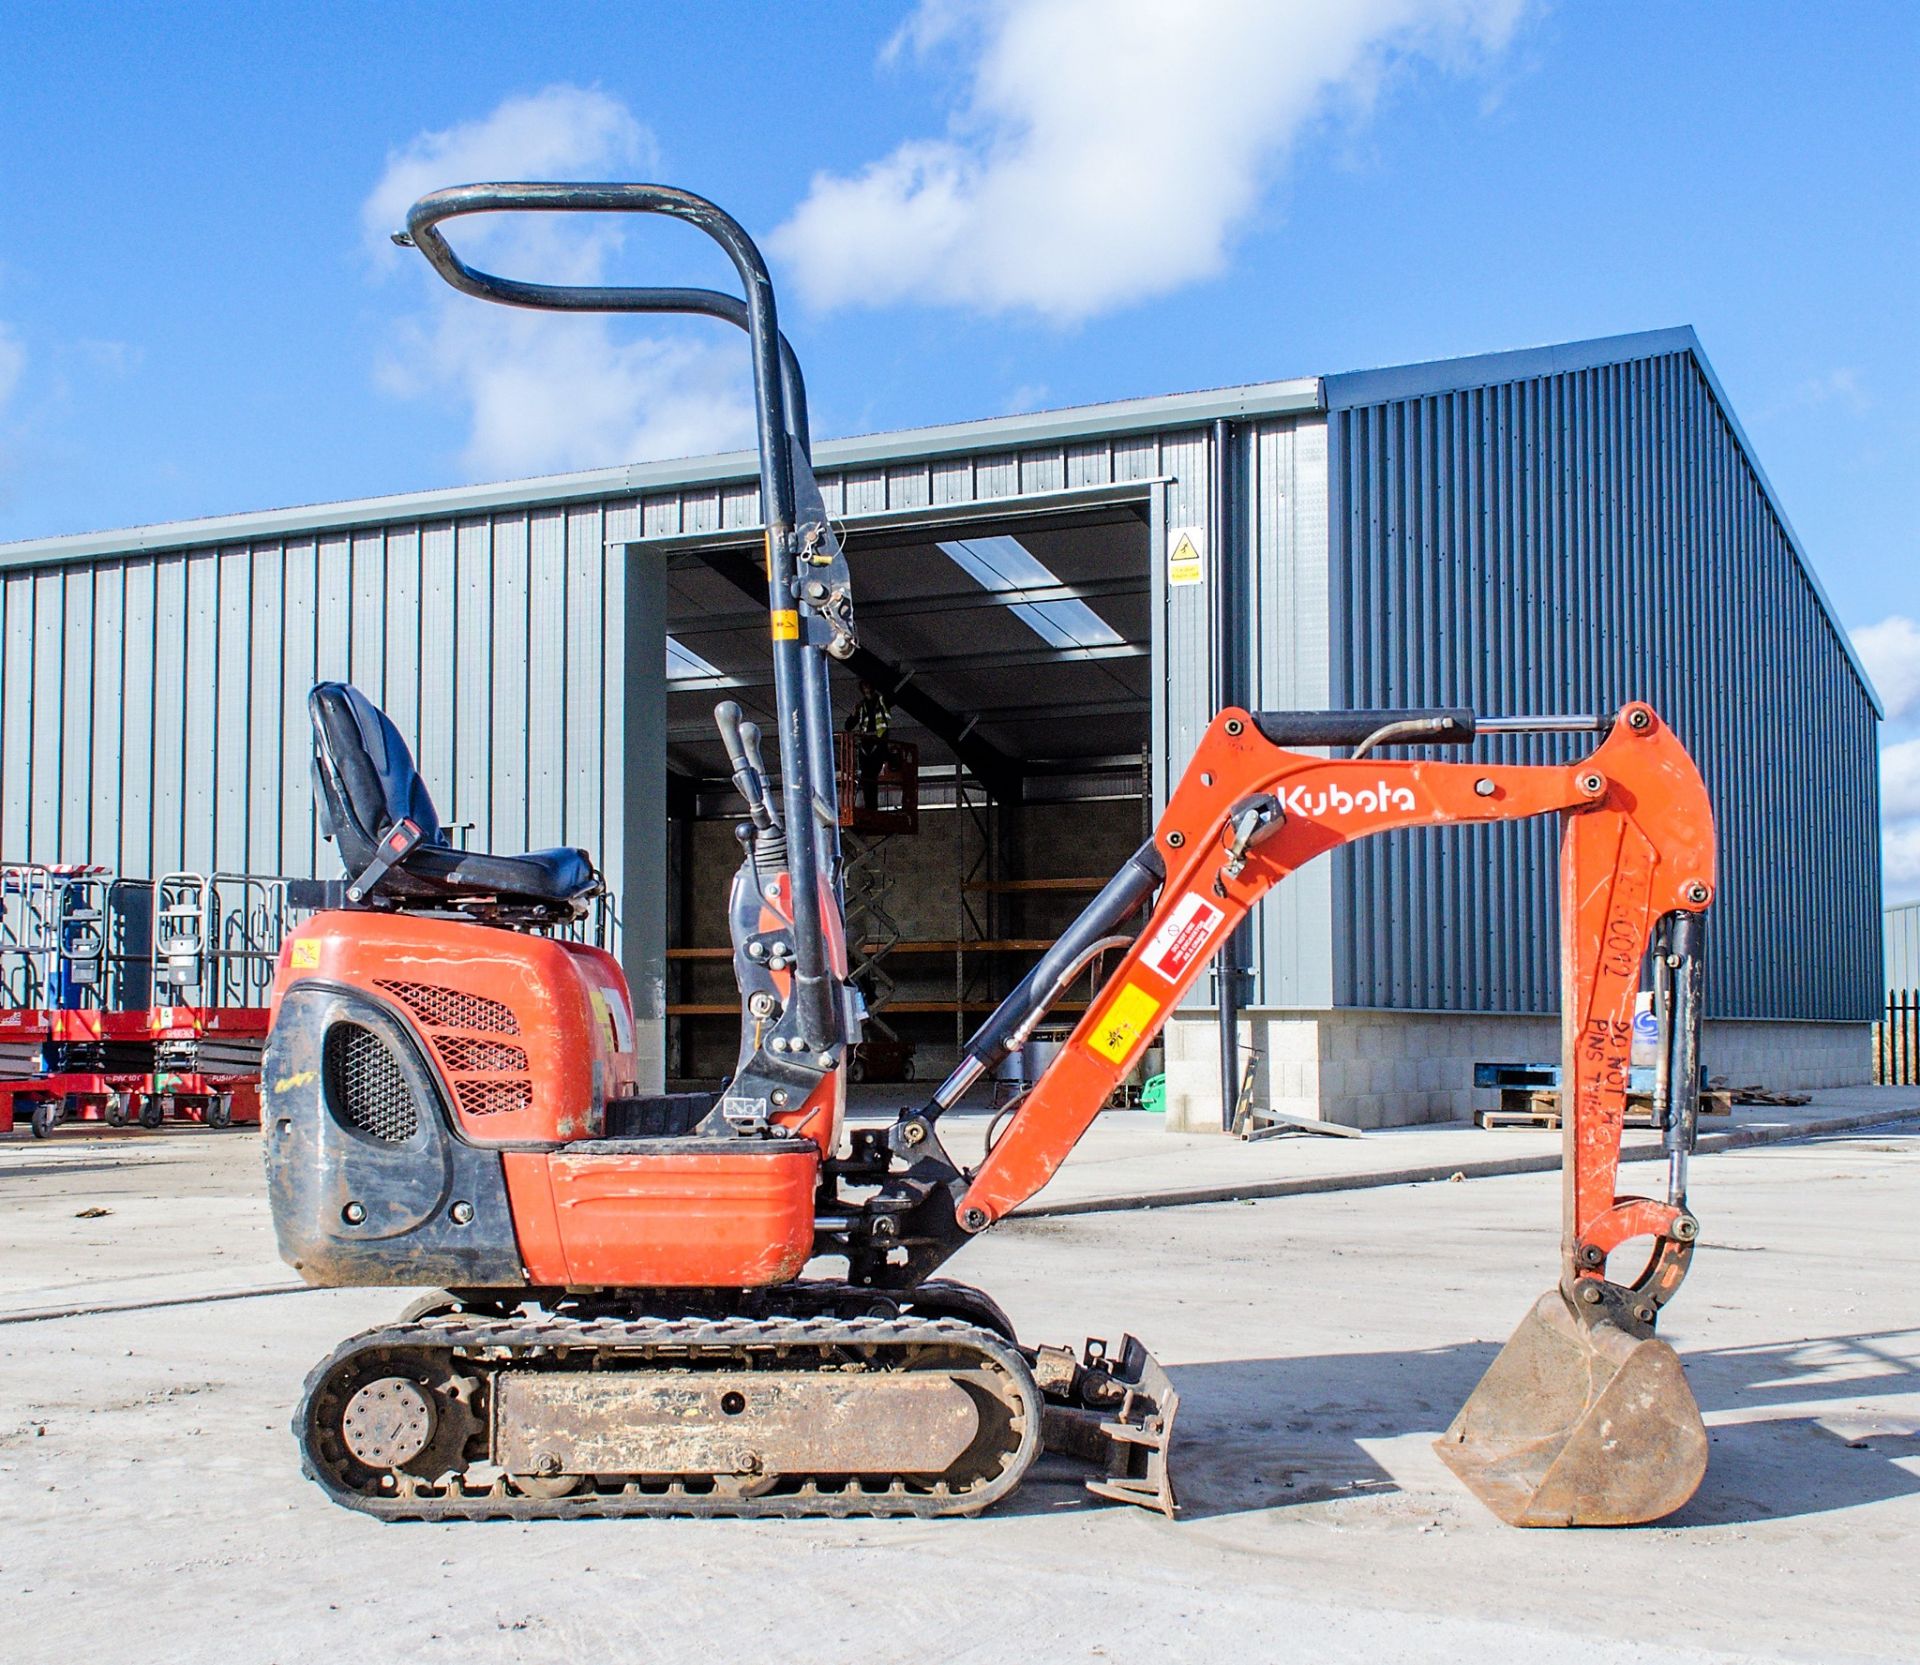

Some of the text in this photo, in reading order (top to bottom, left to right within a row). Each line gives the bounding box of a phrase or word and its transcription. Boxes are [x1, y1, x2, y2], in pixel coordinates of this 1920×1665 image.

[1277, 780, 1416, 817] Kubota
[1170, 943, 1180, 953] DO
[1177, 932, 1187, 945] NOT
[1611, 1021, 1630, 1047] DO
[1604, 1056, 1627, 1096] NOT
